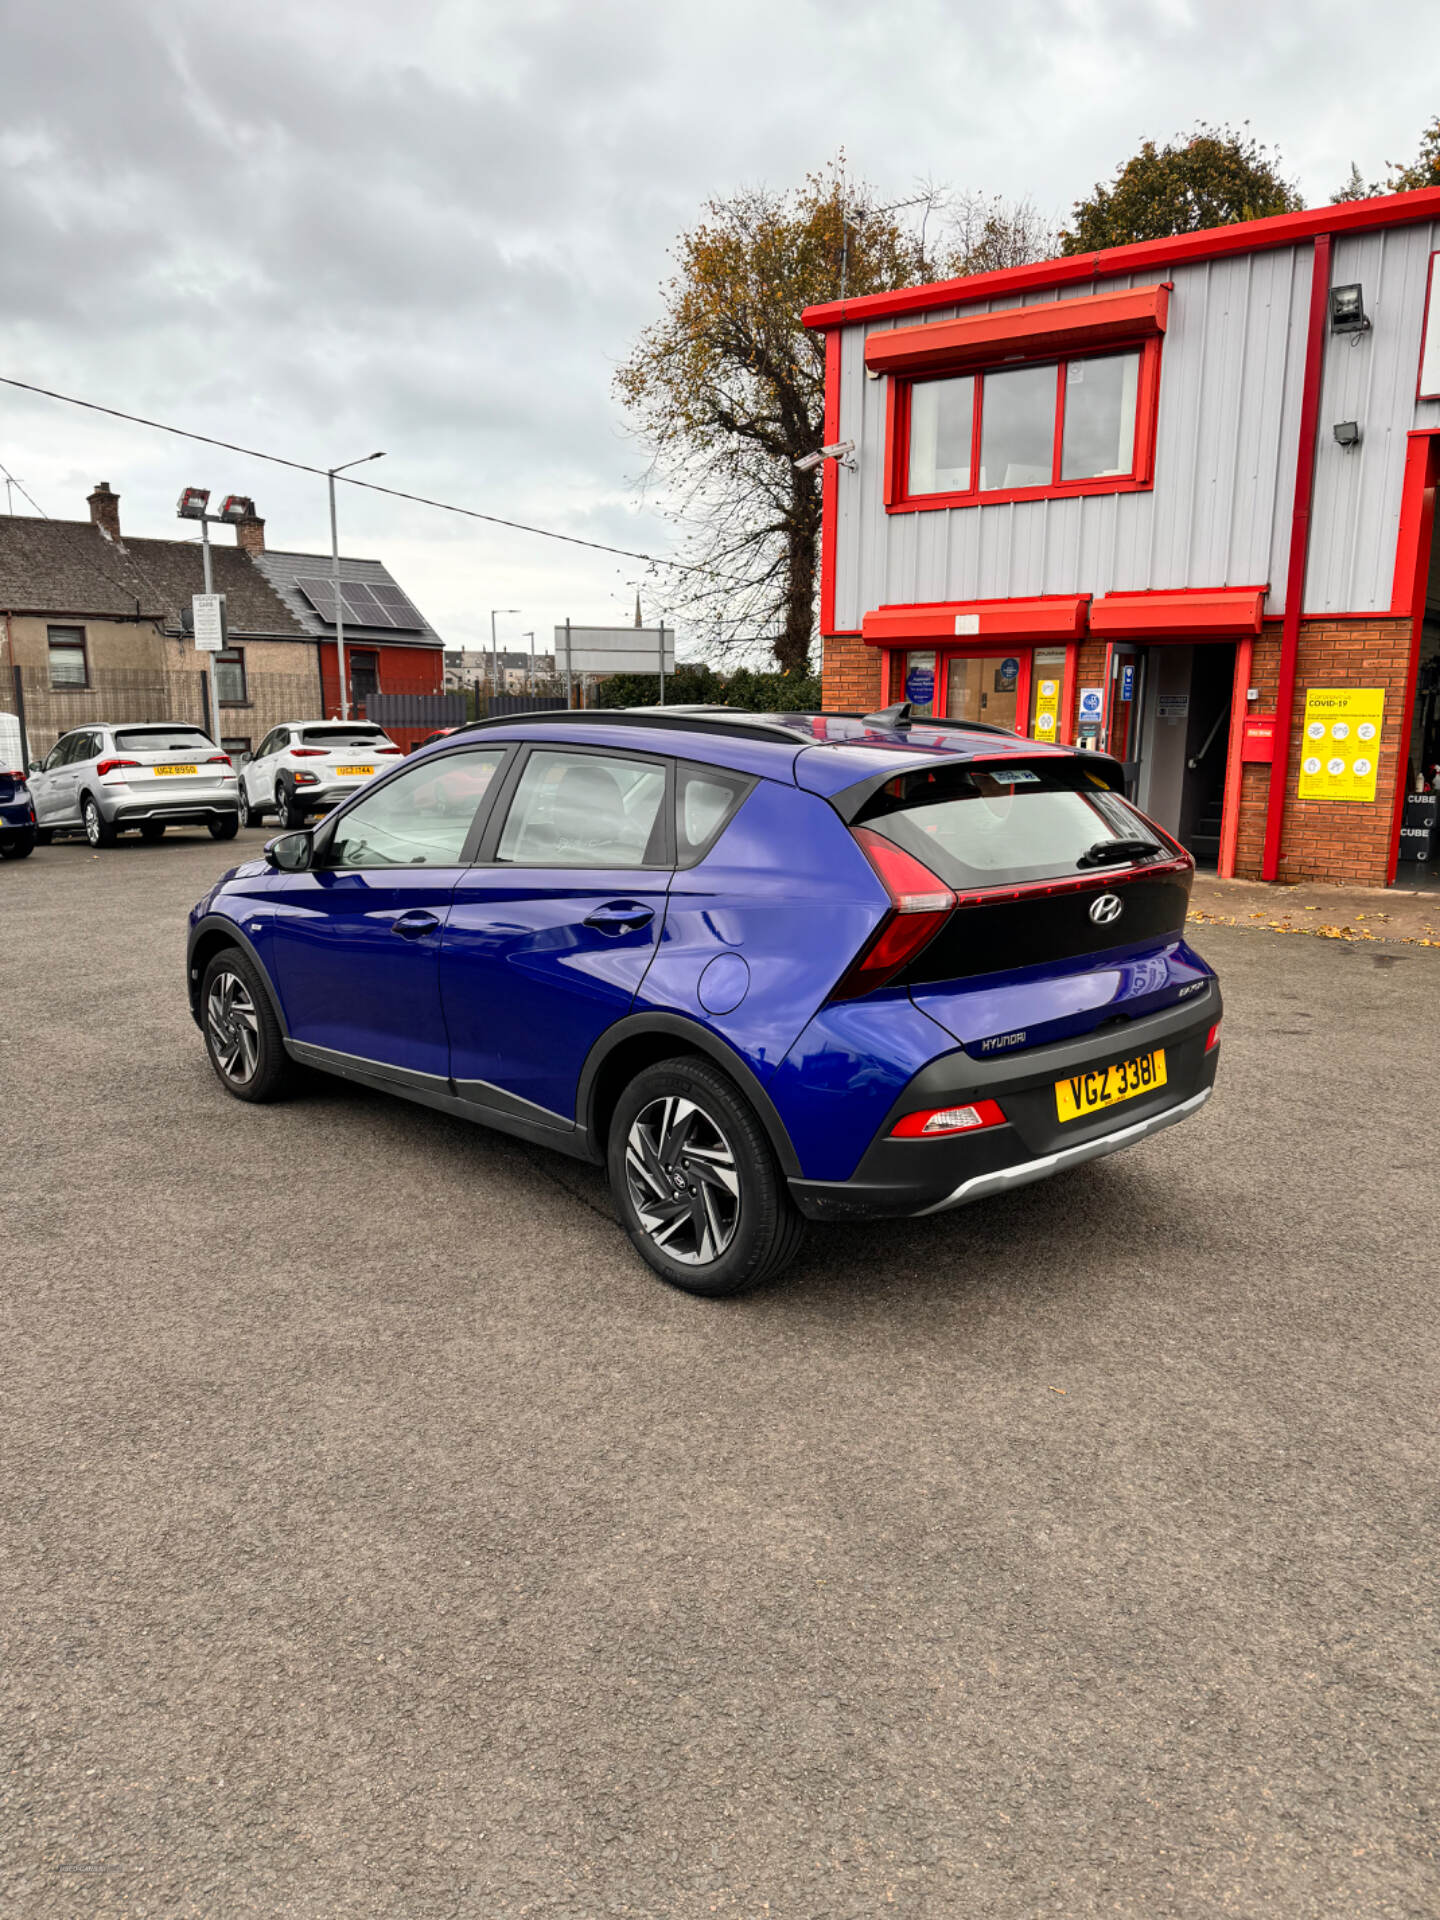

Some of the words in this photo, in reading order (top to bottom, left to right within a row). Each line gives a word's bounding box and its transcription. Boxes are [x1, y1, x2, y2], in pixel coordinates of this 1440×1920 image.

[1309, 699, 1348, 707] COVID-19
[1408, 795, 1436, 804] CUBE
[1400, 828, 1429, 837] CUBE
[981, 1031, 1026, 1051] HYUNDAI
[1070, 1069, 1111, 1110] VGZ
[1116, 1052, 1157, 1094] 3381
